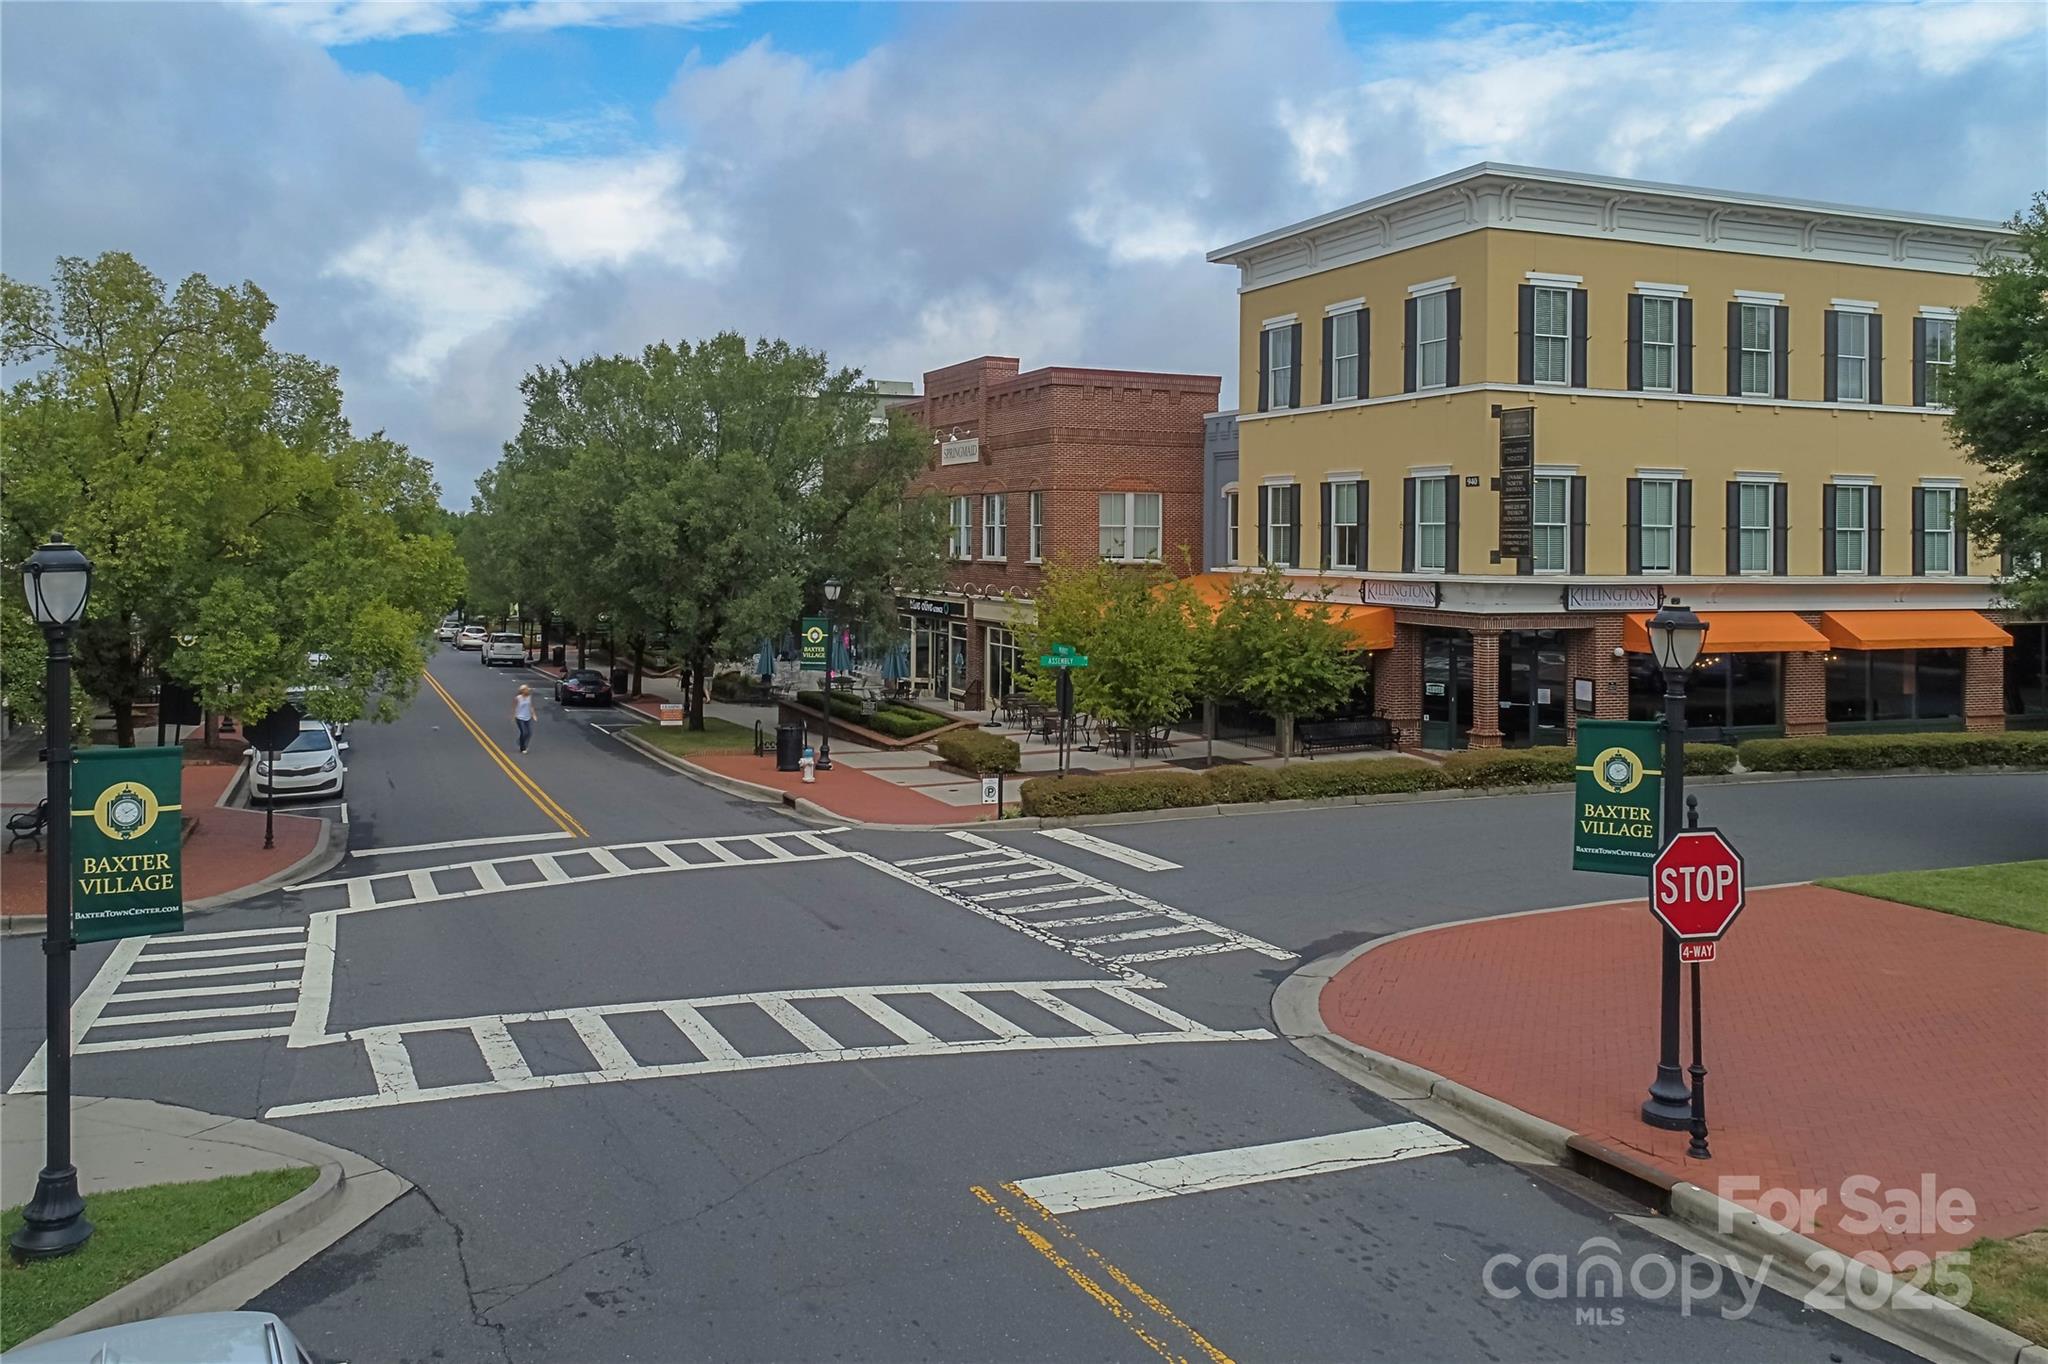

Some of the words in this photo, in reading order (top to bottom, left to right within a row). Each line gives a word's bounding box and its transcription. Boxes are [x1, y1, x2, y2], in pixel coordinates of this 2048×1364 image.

[943, 444, 978, 459] SPRINGMAID
[1466, 477, 1478, 486] 940
[1367, 582, 1436, 604] KILLINGTONS
[1570, 586, 1656, 607] KILLINGTONS
[1047, 657, 1074, 665] ASSEMBLY
[1584, 804, 1651, 821] BAXTER
[1580, 820, 1653, 838] VILLAGE
[83, 853, 171, 874] BAXTER
[79, 874, 174, 895] VILLAGE
[1660, 864, 1734, 905] STOP
[1682, 944, 1713, 958] 4-WAY
